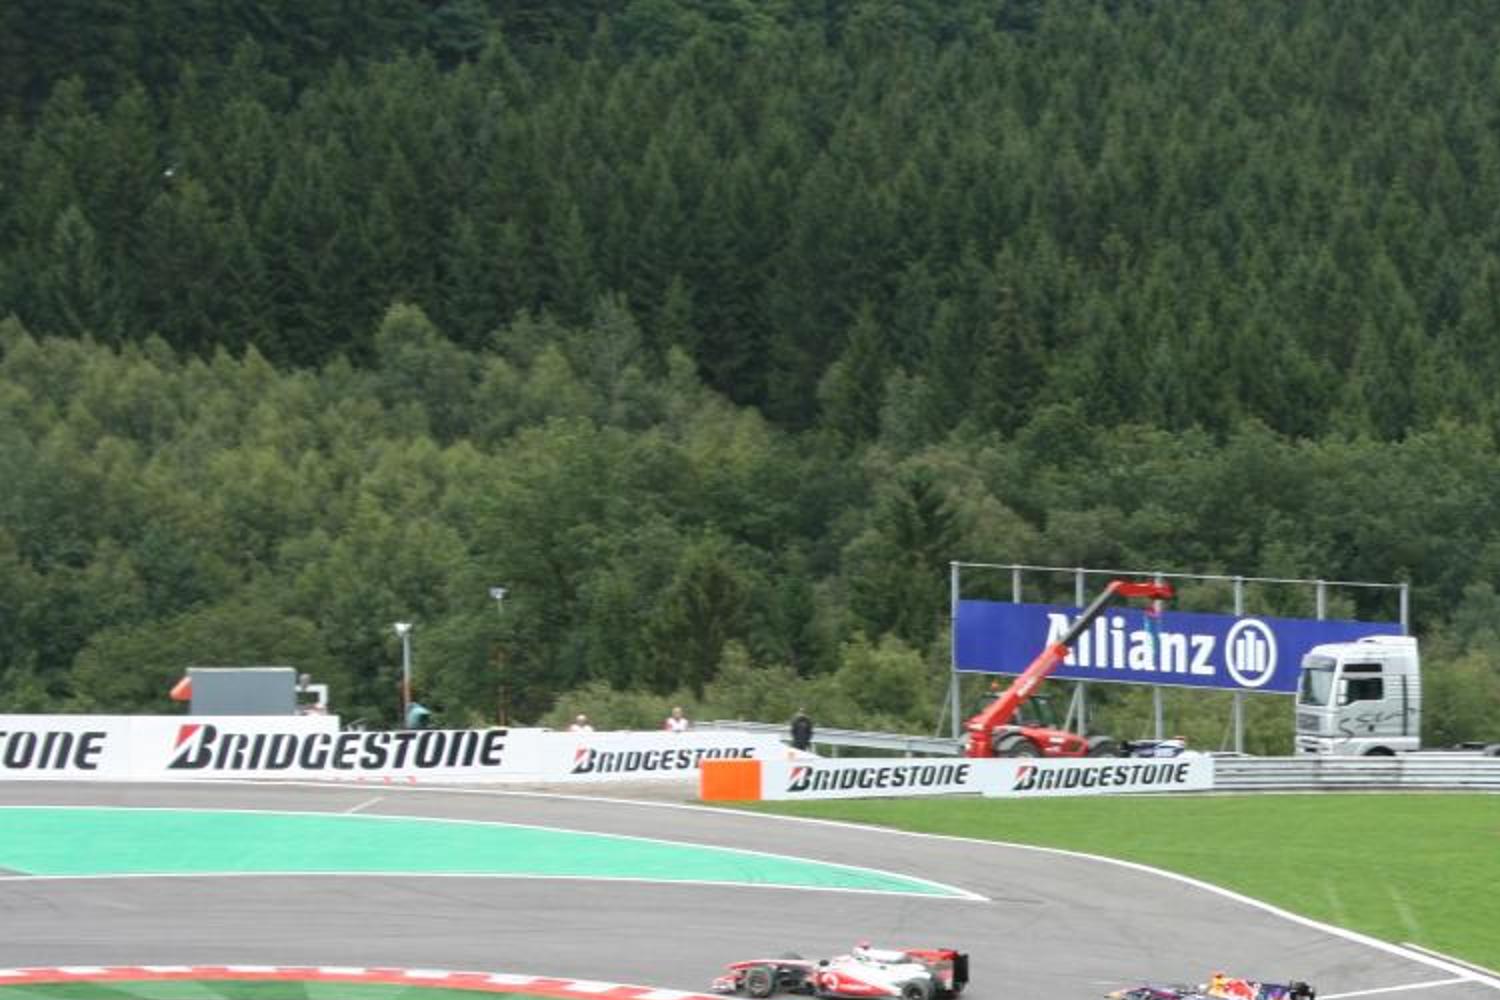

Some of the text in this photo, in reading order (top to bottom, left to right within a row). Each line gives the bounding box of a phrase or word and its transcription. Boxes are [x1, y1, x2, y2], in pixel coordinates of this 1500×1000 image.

[0, 731, 107, 770] ONE
[166, 724, 508, 770] BRIDGESTONE
[787, 764, 970, 792] BRIDGESTONE
[1013, 763, 1190, 791] BRIDGESTONE
